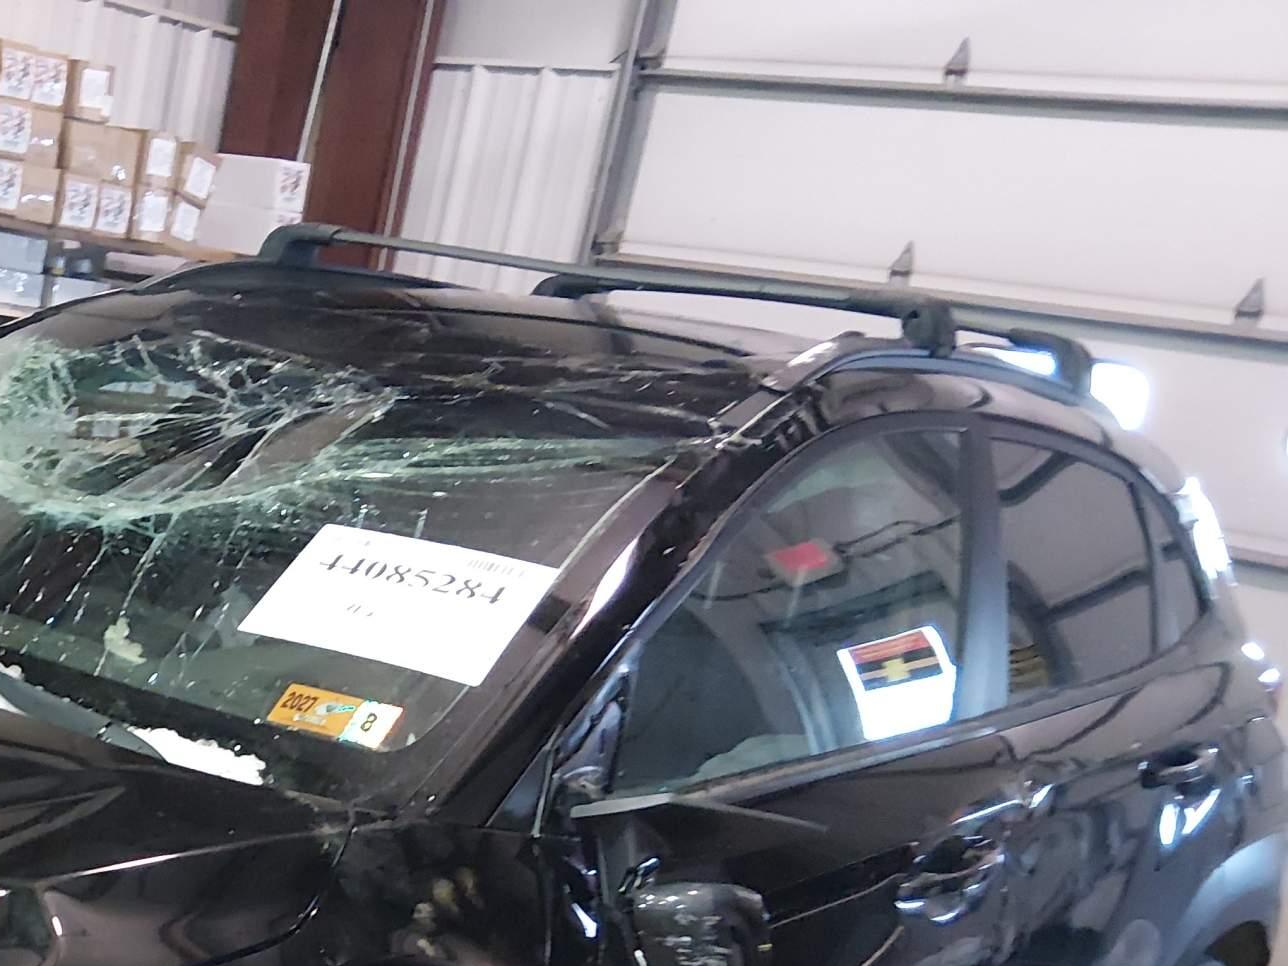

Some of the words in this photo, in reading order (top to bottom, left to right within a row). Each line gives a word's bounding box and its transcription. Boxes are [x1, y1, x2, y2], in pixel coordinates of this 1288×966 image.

[319, 554, 506, 604] 44085284
[280, 692, 320, 713] 2027
[360, 713, 378, 732] 8
